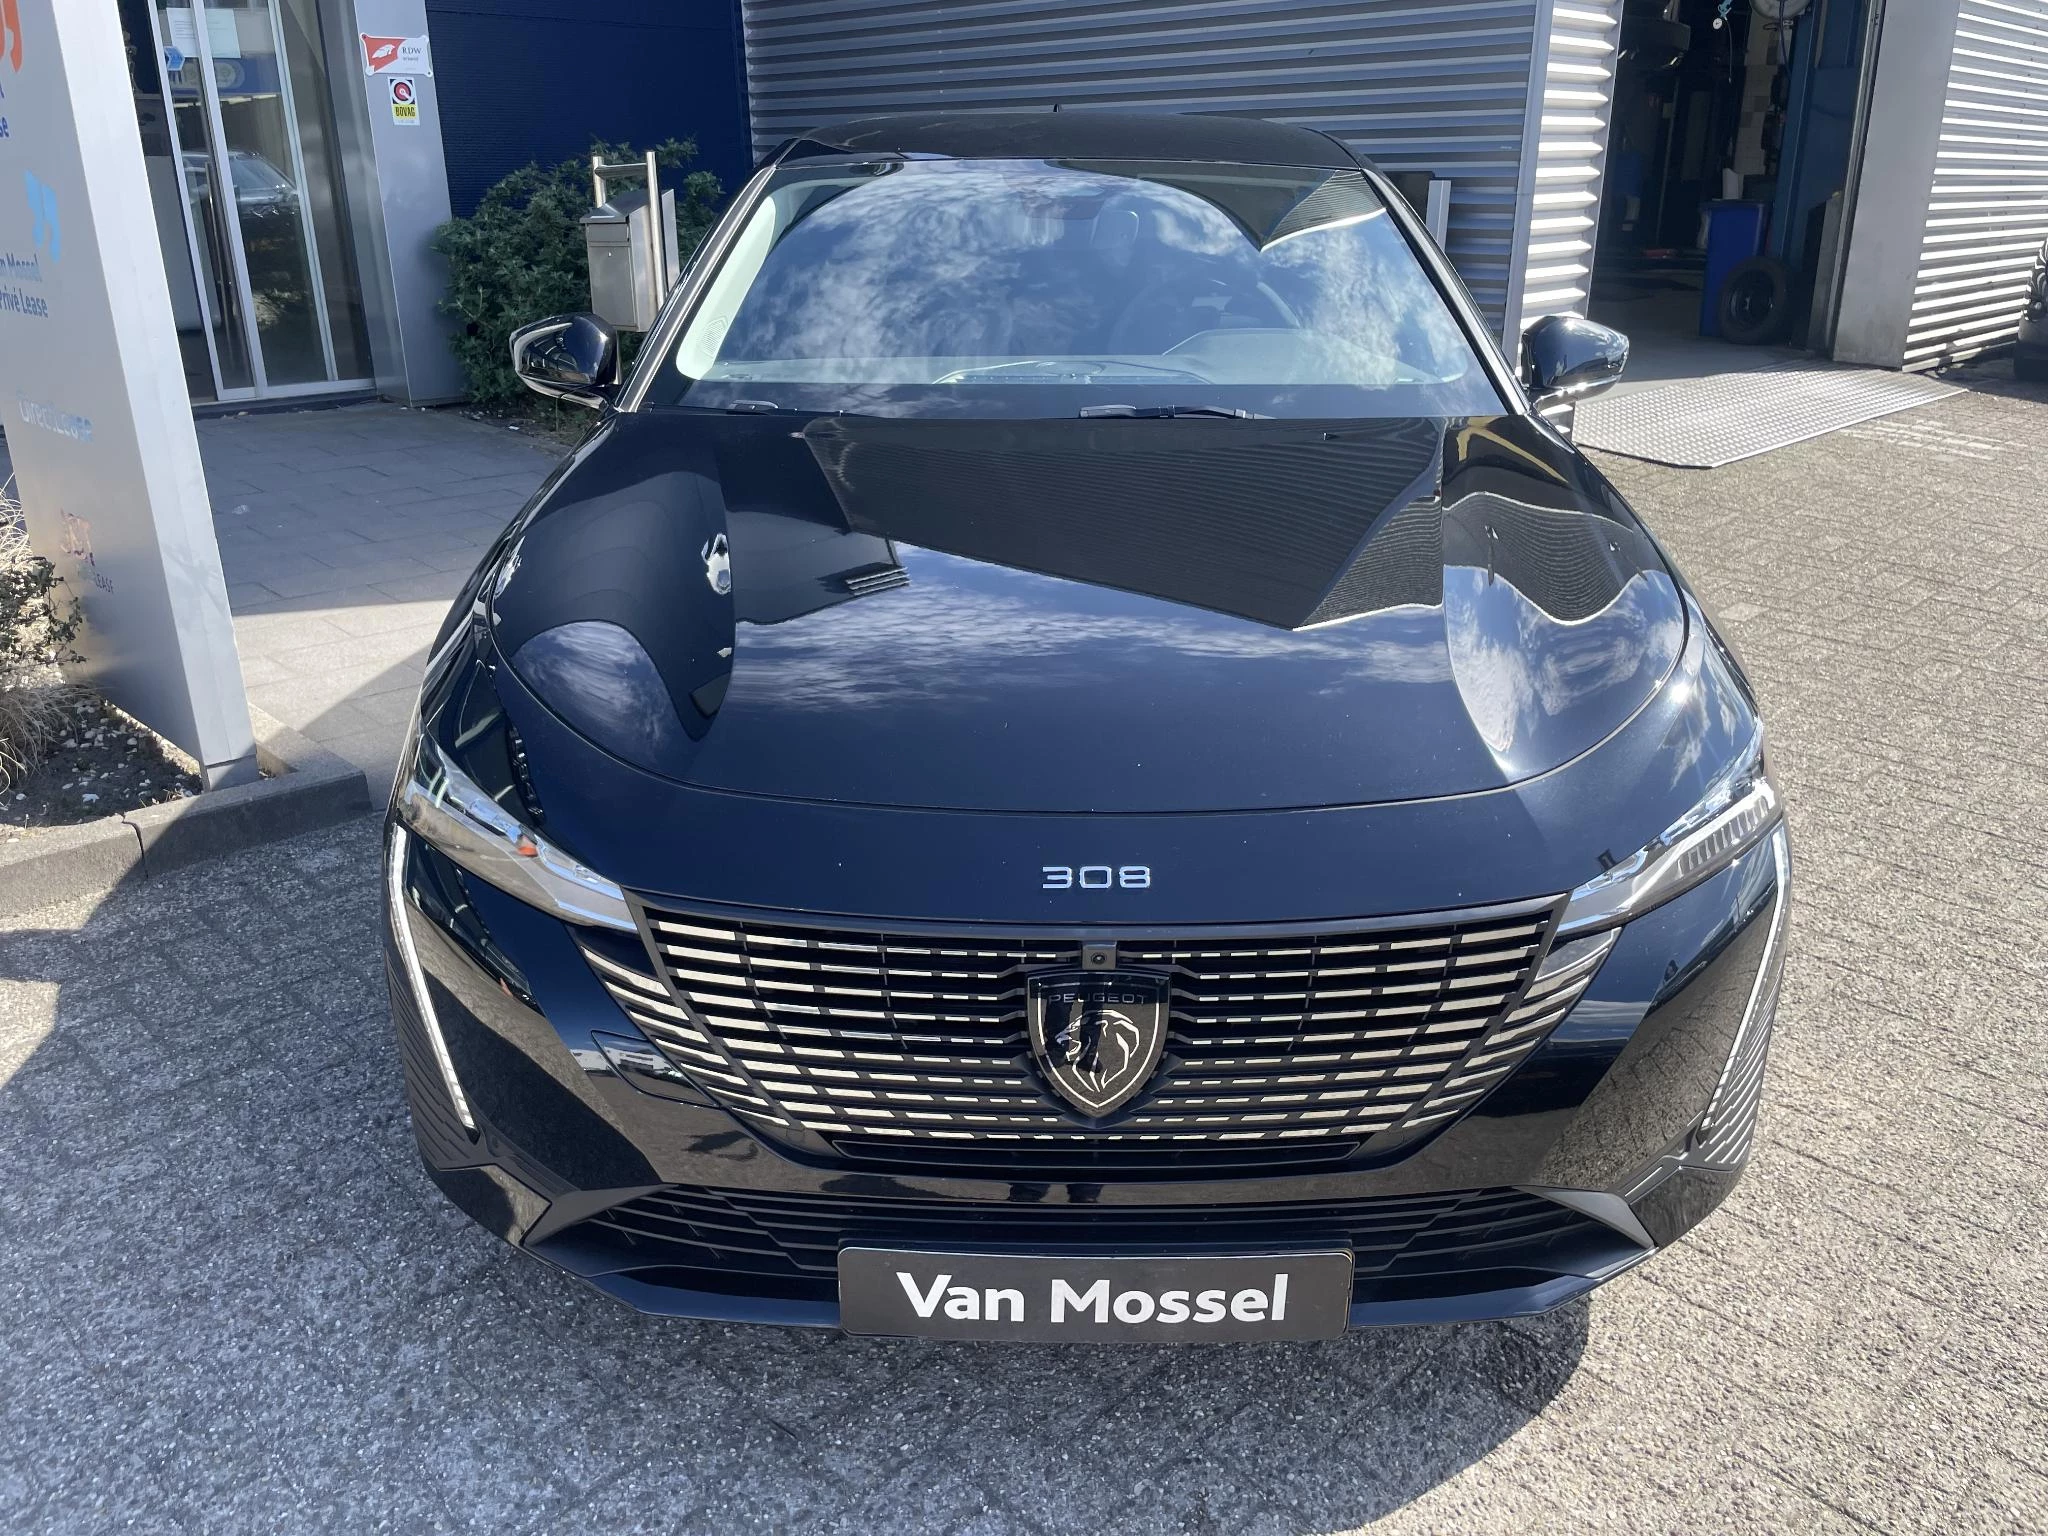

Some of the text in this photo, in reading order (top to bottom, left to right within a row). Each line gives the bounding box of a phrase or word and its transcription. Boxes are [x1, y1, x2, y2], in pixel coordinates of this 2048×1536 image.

[402, 46, 421, 54] RDW
[395, 106, 416, 117] BOVAG
[19, 287, 48, 318] Lease
[1042, 866, 1151, 889] 308
[1048, 992, 1148, 1004] PEUGEOT
[896, 1271, 1289, 1324] Van Mossel
